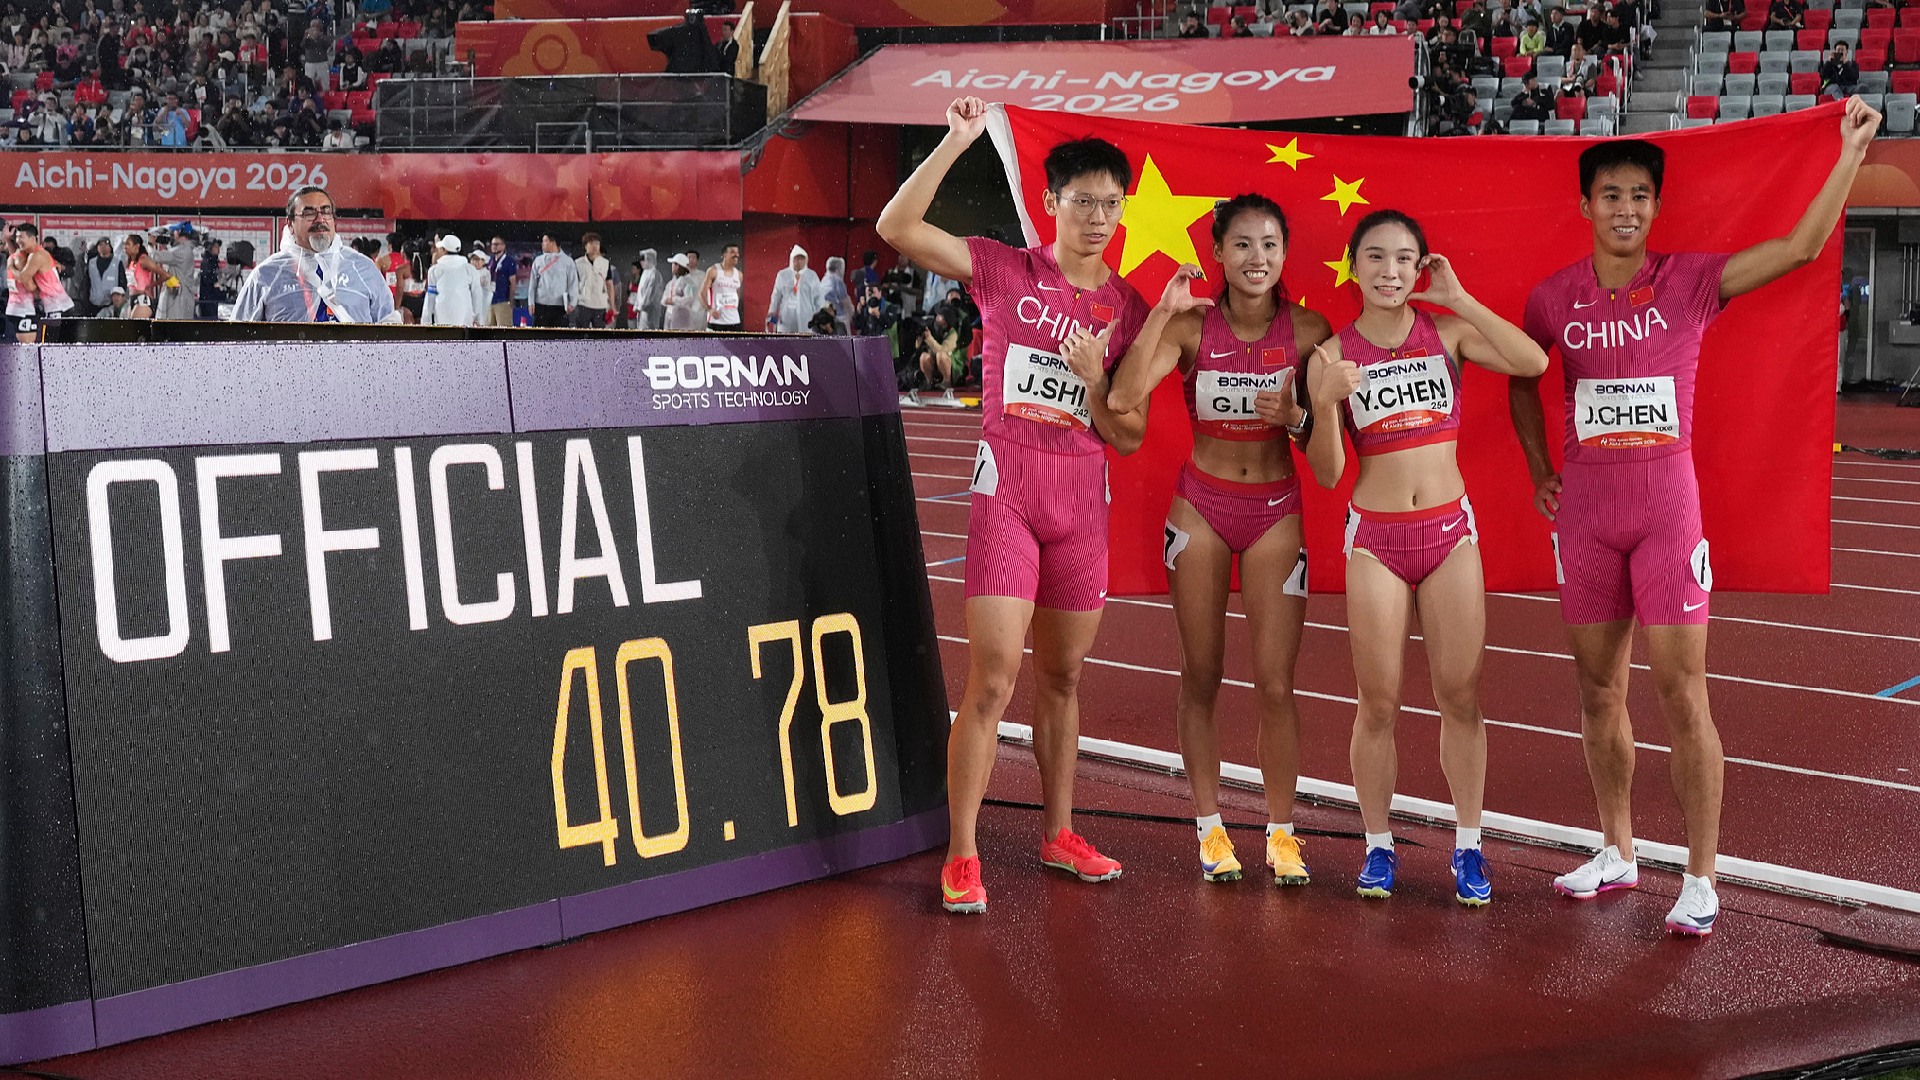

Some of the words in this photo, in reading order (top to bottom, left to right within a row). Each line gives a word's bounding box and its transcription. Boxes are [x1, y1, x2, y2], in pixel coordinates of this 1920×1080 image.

[911, 65, 1336, 94] Aichi-Nagoya
[1027, 93, 1180, 113] 2026
[14, 158, 236, 199] Aichi-Nagoya
[246, 163, 328, 191] 2026
[1564, 307, 1668, 349] CHINA
[642, 354, 810, 390] BORNAN
[1029, 353, 1071, 373] BORN
[1367, 361, 1427, 379] BORNAN
[1018, 373, 1087, 407] J.SHI
[1217, 375, 1277, 388] BORNAN
[1595, 383, 1656, 394] BORNAN
[652, 392, 710, 410] SPORTS
[714, 390, 811, 408] TECHNOLOGY
[1213, 396, 1254, 414] G.L
[1356, 377, 1447, 412] Y.CHEN
[1431, 400, 1448, 410] 254
[1073, 408, 1089, 418] 242
[1585, 403, 1668, 426] J.CHEN
[85, 436, 703, 663] OFFICIAL
[550, 612, 877, 866] 40.78
